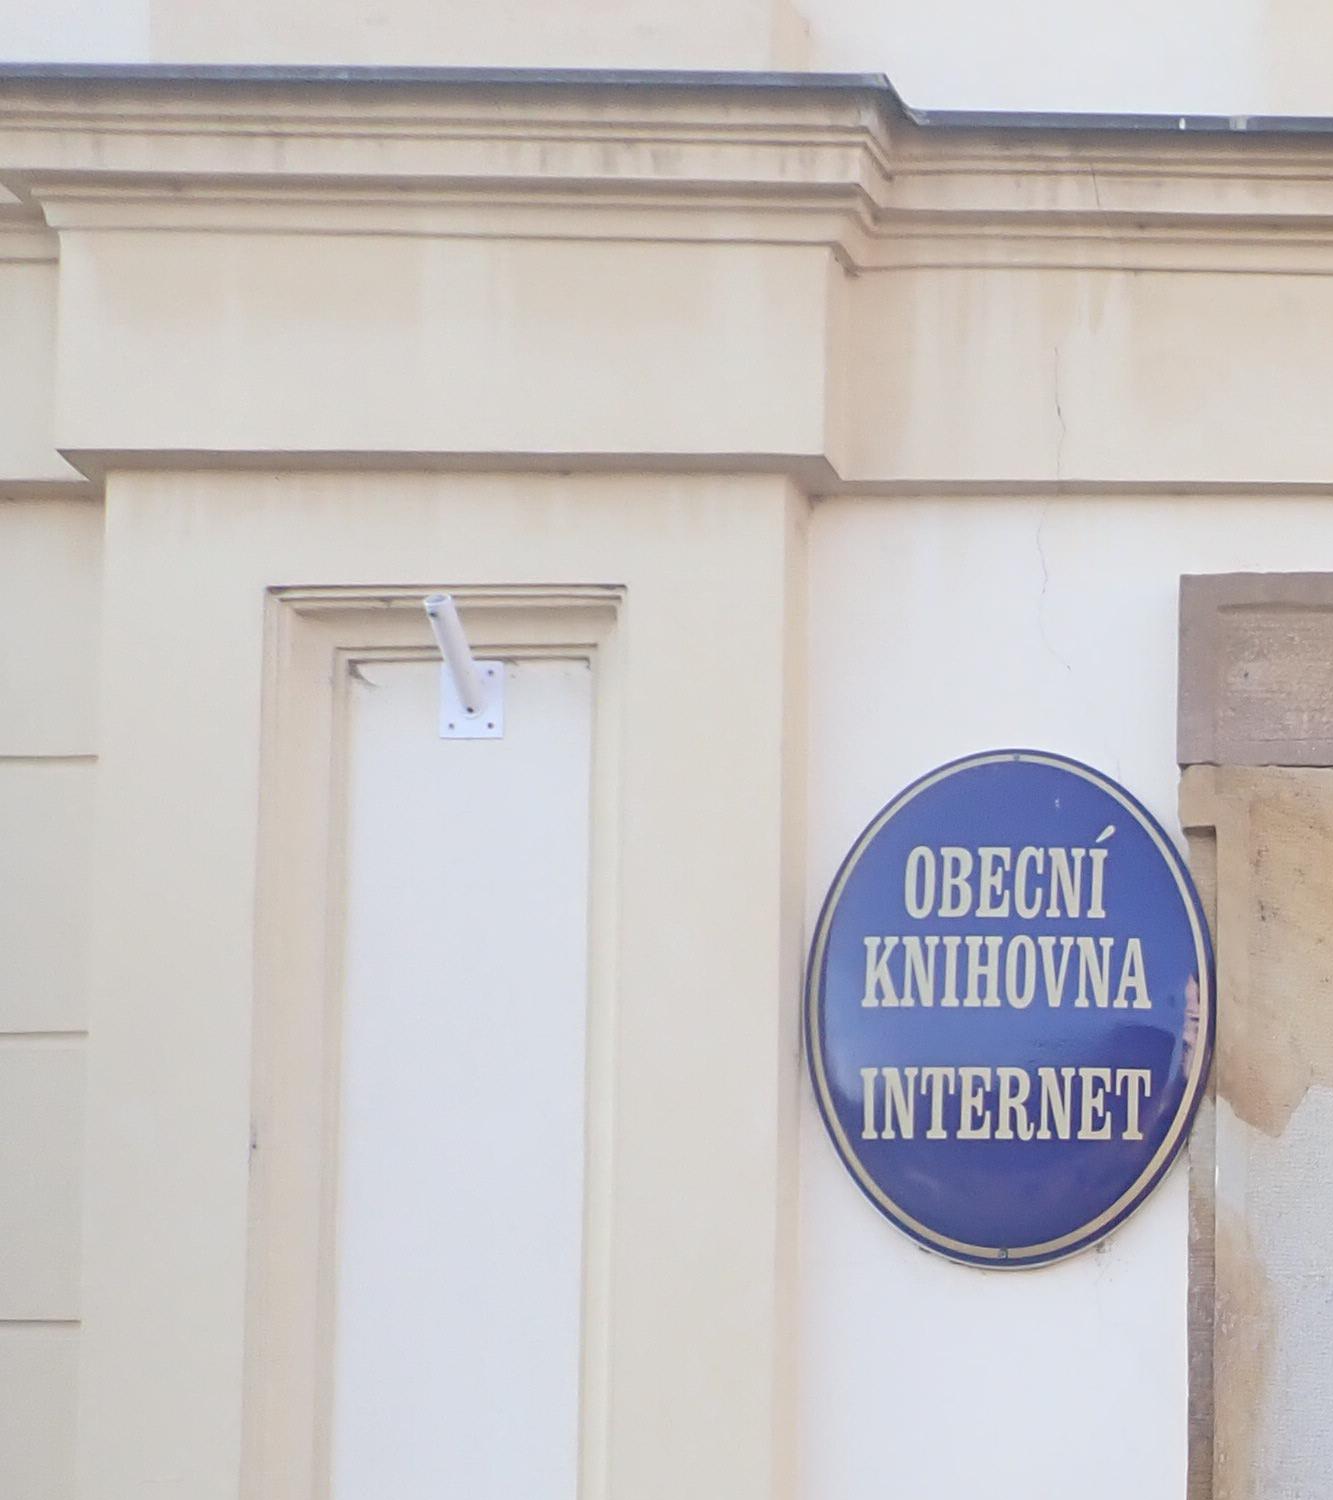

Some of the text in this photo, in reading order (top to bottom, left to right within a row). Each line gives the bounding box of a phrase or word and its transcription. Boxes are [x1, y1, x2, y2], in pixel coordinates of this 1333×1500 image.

[904, 825, 1116, 919] OBECNÍ
[861, 934, 1152, 1009] KNIHOVNA
[860, 1067, 1151, 1140] INTERNET
